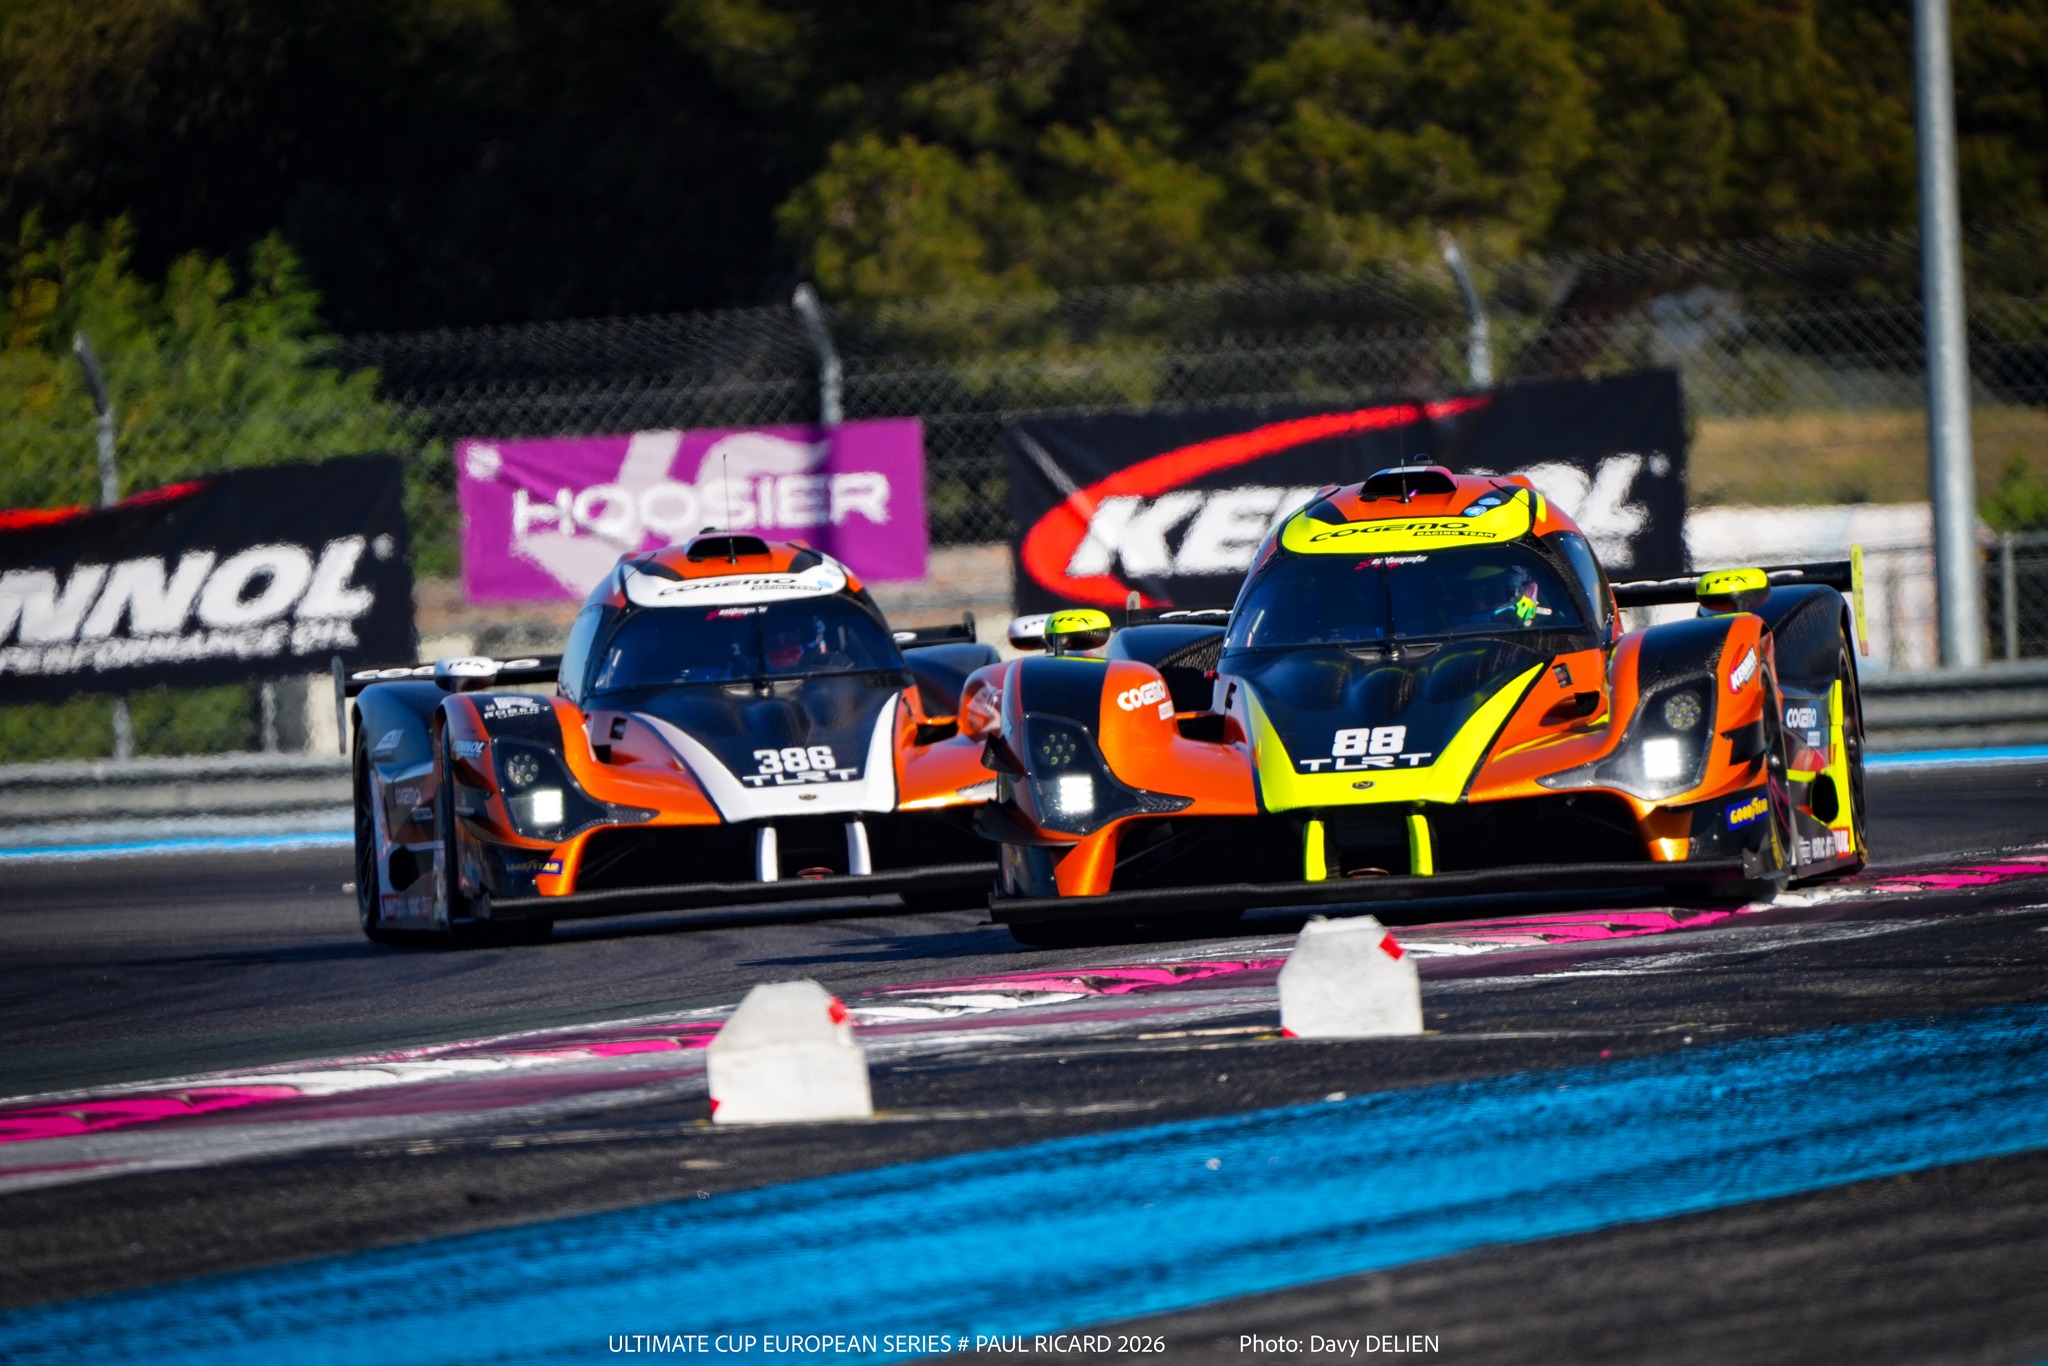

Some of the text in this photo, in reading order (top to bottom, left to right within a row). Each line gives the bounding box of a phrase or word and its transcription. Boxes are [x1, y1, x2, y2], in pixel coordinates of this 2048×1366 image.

[511, 471, 891, 540] HOOSIER
[1309, 522, 1470, 543] COGEMO
[658, 576, 797, 597] COGEMO
[1332, 725, 1407, 757] 88
[753, 745, 836, 775] 386
[1300, 752, 1432, 772] TLRT
[742, 767, 858, 786] TLRT
